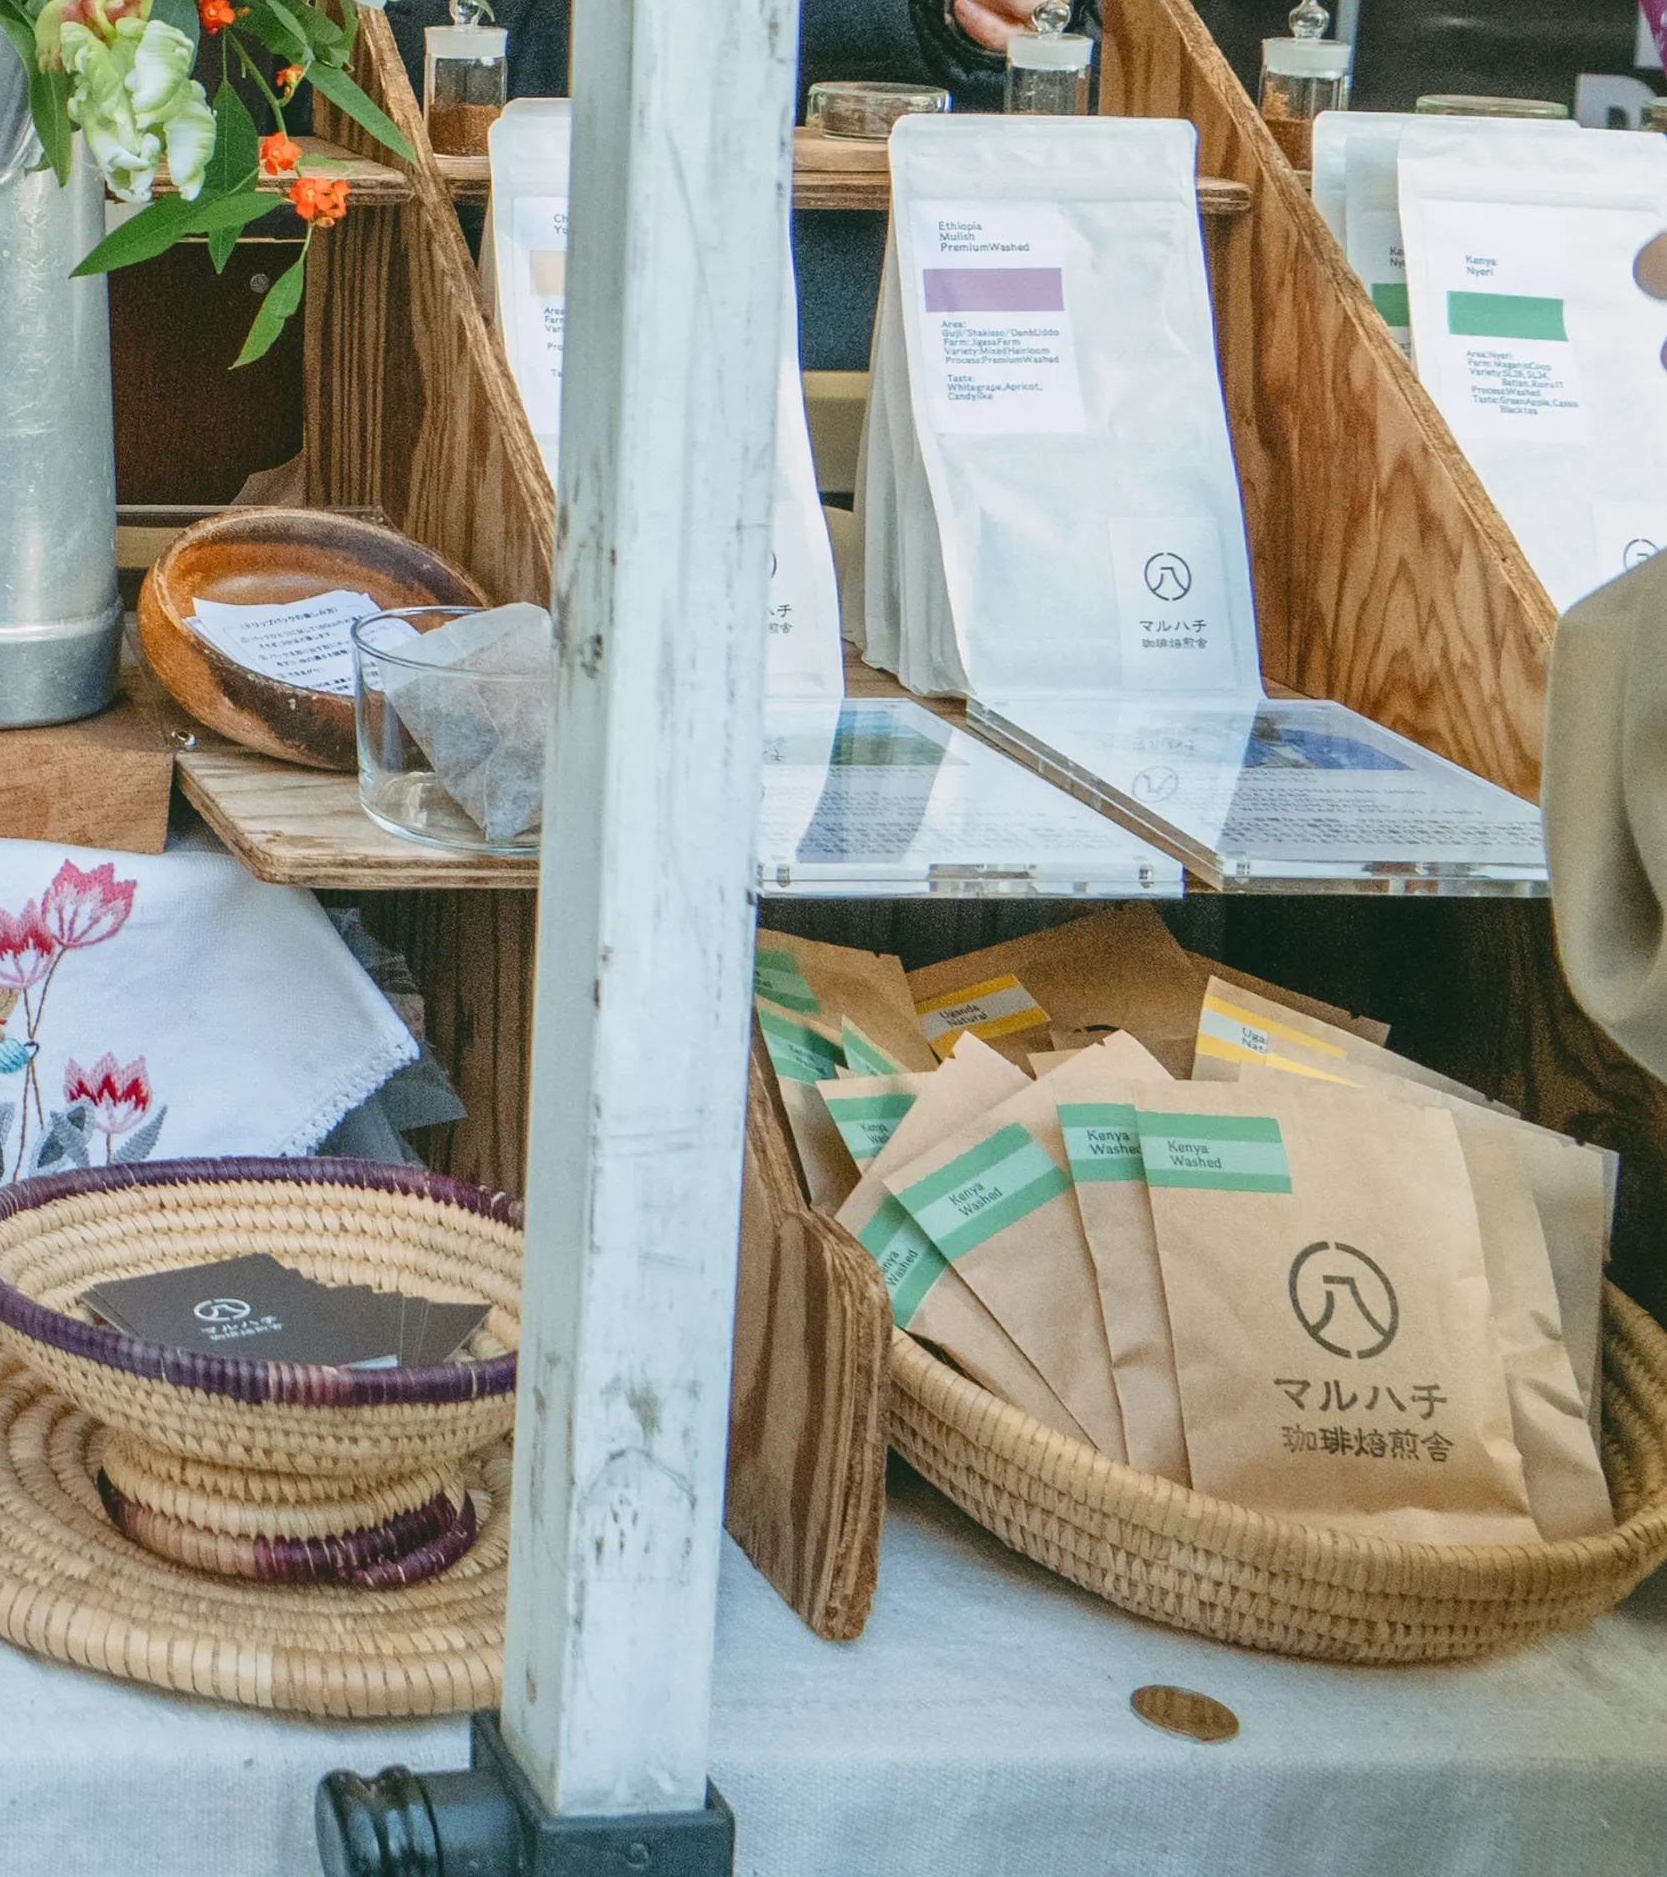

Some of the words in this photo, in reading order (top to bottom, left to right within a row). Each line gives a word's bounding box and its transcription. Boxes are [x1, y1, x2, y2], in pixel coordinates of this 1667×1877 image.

[938, 221, 983, 232] Ethiopia
[1139, 618, 1208, 634] マルハチ
[938, 1004, 980, 1021] Uganda
[946, 1011, 988, 1028] Natural
[1087, 1130, 1129, 1144] Kenya
[1168, 1140, 1209, 1155] Kenya
[1170, 1155, 1222, 1169] Washed
[949, 1181, 984, 1207] Kenya
[958, 1187, 1004, 1217] Washed
[881, 1250, 899, 1275] enya
[886, 1249, 918, 1287] Washed
[1273, 1376, 1449, 1422] マルハチ
[1281, 1424, 1457, 1465] 珈琲焙煎舎
